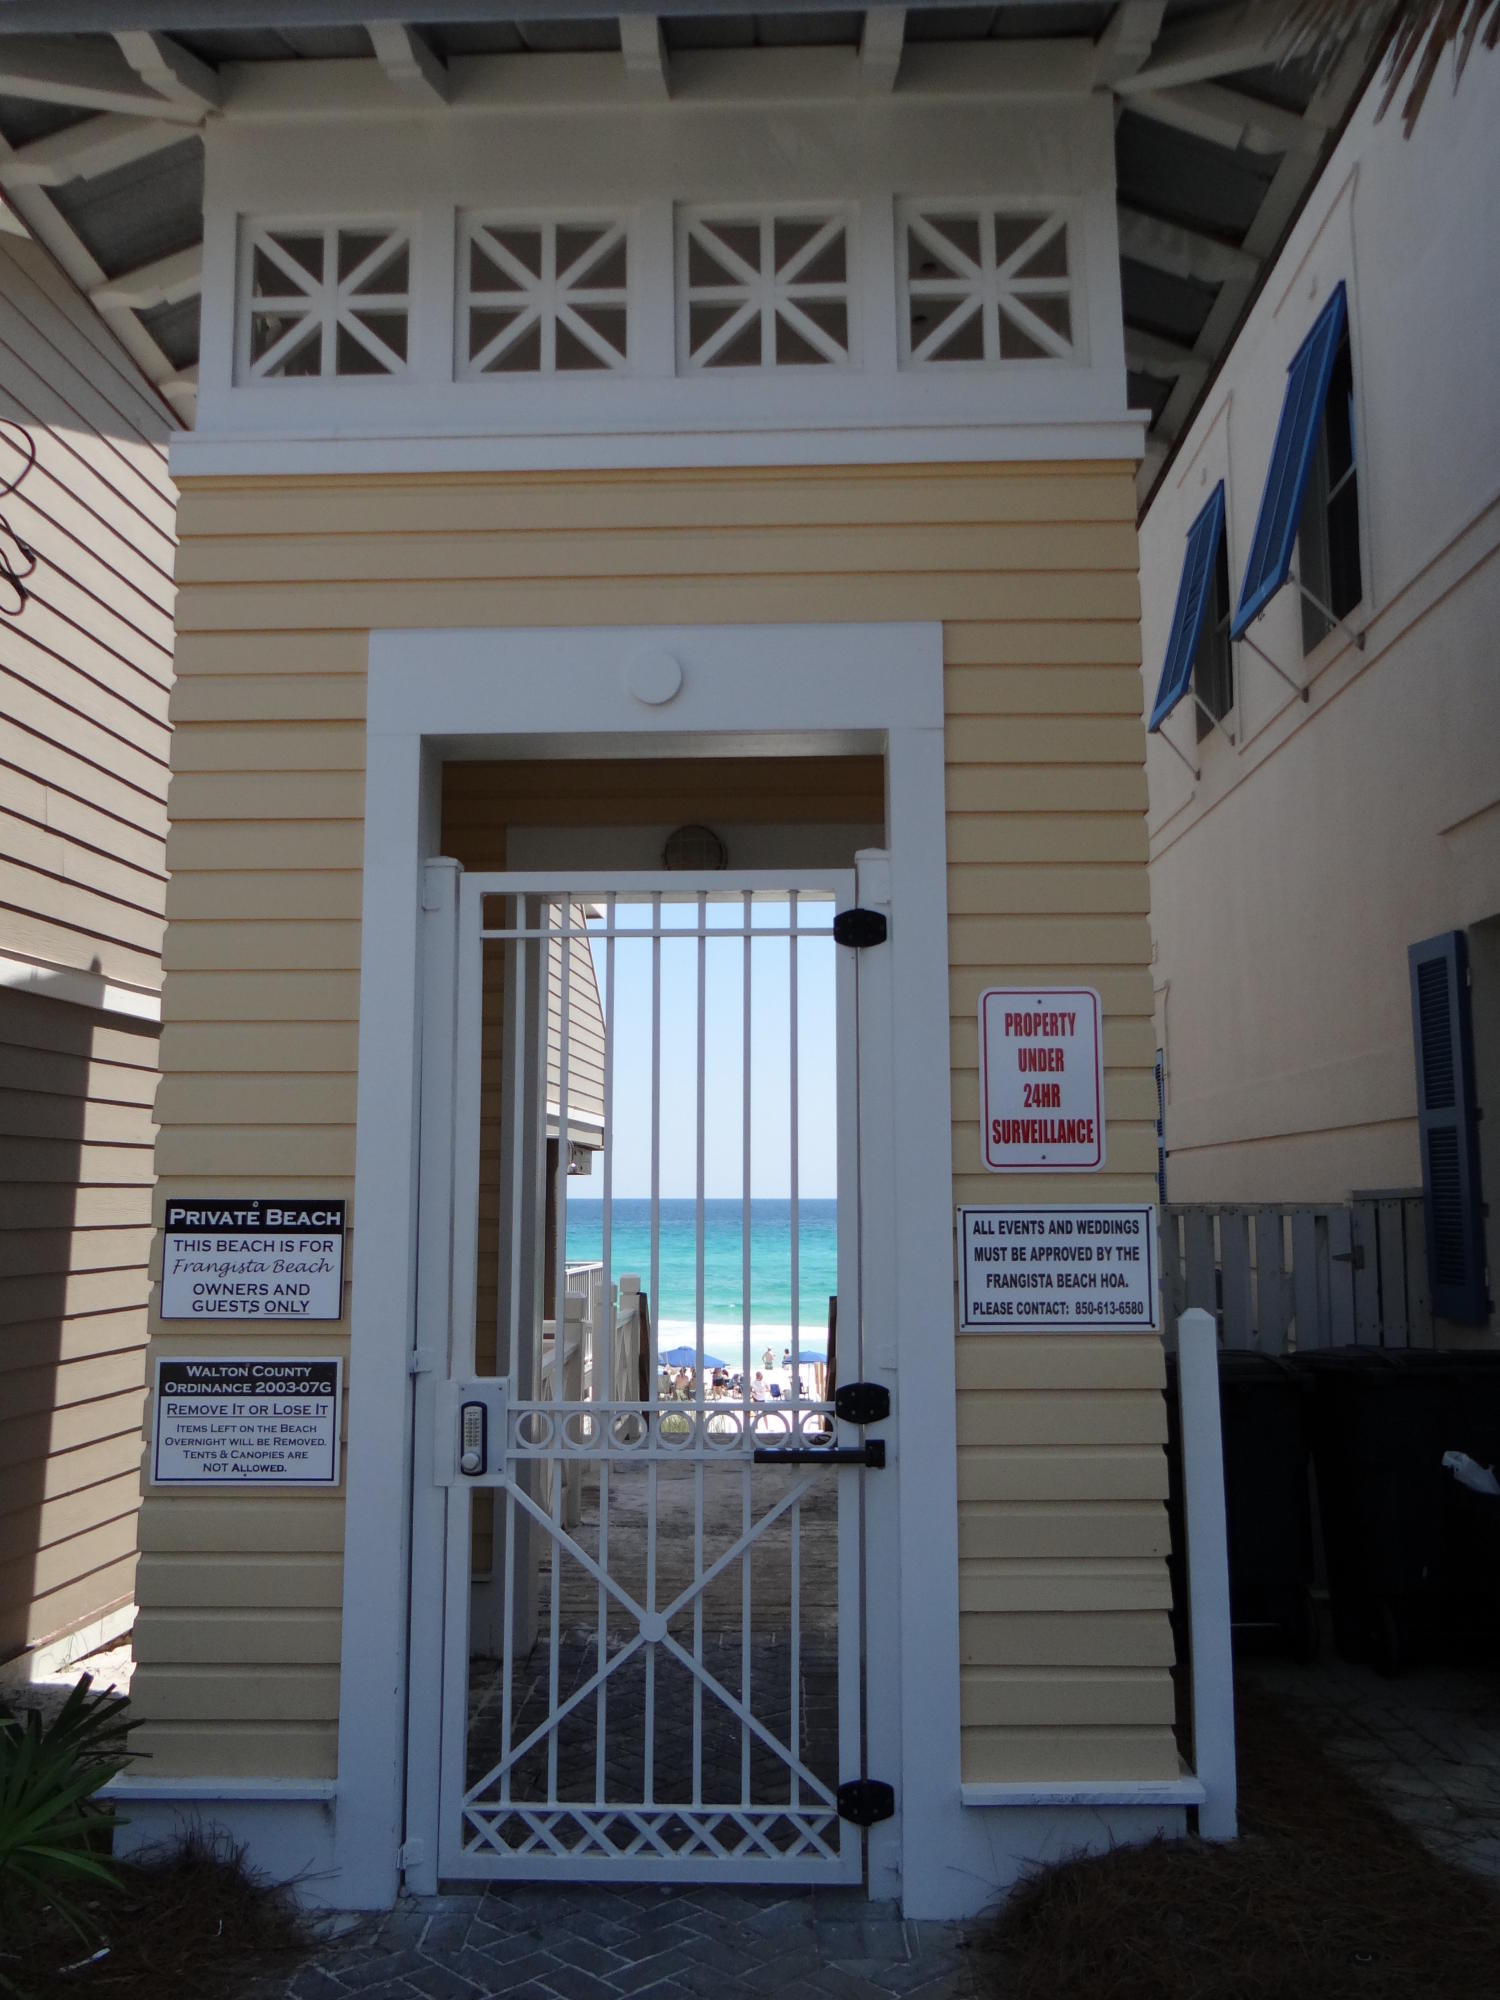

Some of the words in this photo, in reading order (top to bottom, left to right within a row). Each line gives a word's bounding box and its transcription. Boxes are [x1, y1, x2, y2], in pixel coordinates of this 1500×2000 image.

[1005, 1012, 1076, 1037] PROPERTY
[1018, 1048, 1064, 1072] UNDER
[1023, 1083, 1061, 1108] 24HR
[992, 1119, 1094, 1144] SURVEILLANCE
[170, 1208, 260, 1225] PRIVATE
[266, 1209, 341, 1225] BEACH
[973, 1220, 994, 1234] ALL
[999, 1220, 1045, 1234] EVENTS
[1049, 1220, 1072, 1234] AND
[1077, 1220, 1139, 1234] WEDDINGS
[174, 1240, 212, 1252] THIS
[216, 1240, 274, 1252] BEACH
[280, 1241, 294, 1252] IS
[300, 1241, 333, 1252] FOR
[974, 1247, 1007, 1262] MUST
[1011, 1247, 1026, 1261] BE
[1030, 1247, 1092, 1261] APPROVED
[1097, 1247, 1112, 1261] BY
[1116, 1247, 1139, 1261] THE
[173, 1258, 271, 1277] Frangista
[273, 1258, 335, 1273] Beach
[986, 1274, 1053, 1288] FRANGISTA
[1057, 1274, 1096, 1288] BEACH
[1101, 1274, 1128, 1288] HOA.
[193, 1283, 268, 1295] OWNERS
[273, 1284, 310, 1295] AND
[192, 1300, 259, 1312] GUESTS
[264, 1300, 310, 1312] ONLY
[973, 1302, 1013, 1315] PLEASE
[1017, 1302, 1069, 1315] CONTACT:
[1075, 1302, 1143, 1315] 850-613-6580
[186, 1366, 249, 1377] WALTON
[252, 1366, 312, 1377] COUNTY
[165, 1382, 251, 1393] ORDINANCE
[256, 1382, 331, 1393] 2003-07G
[167, 1403, 227, 1415] REMOVE
[232, 1404, 245, 1415] IT
[249, 1405, 268, 1415] OR
[273, 1404, 311, 1415] LOSE
[315, 1404, 328, 1415] IT
[177, 1424, 207, 1433] ITEMS
[211, 1424, 237, 1433] LEFT
[240, 1425, 254, 1433] ON
[257, 1425, 277, 1433] THE
[281, 1424, 316, 1433] BEACH
[165, 1437, 226, 1446] OVERNIGHT
[229, 1438, 253, 1446] WILL
[257, 1438, 270, 1446] BE
[273, 1438, 326, 1446] REMOVED.
[183, 1450, 217, 1459] TENTS
[219, 1450, 227, 1459] &
[230, 1450, 284, 1459] CANOPIES
[287, 1451, 308, 1459] ARE
[203, 1463, 228, 1472] NOT
[232, 1464, 287, 1472] ALLOWED.
